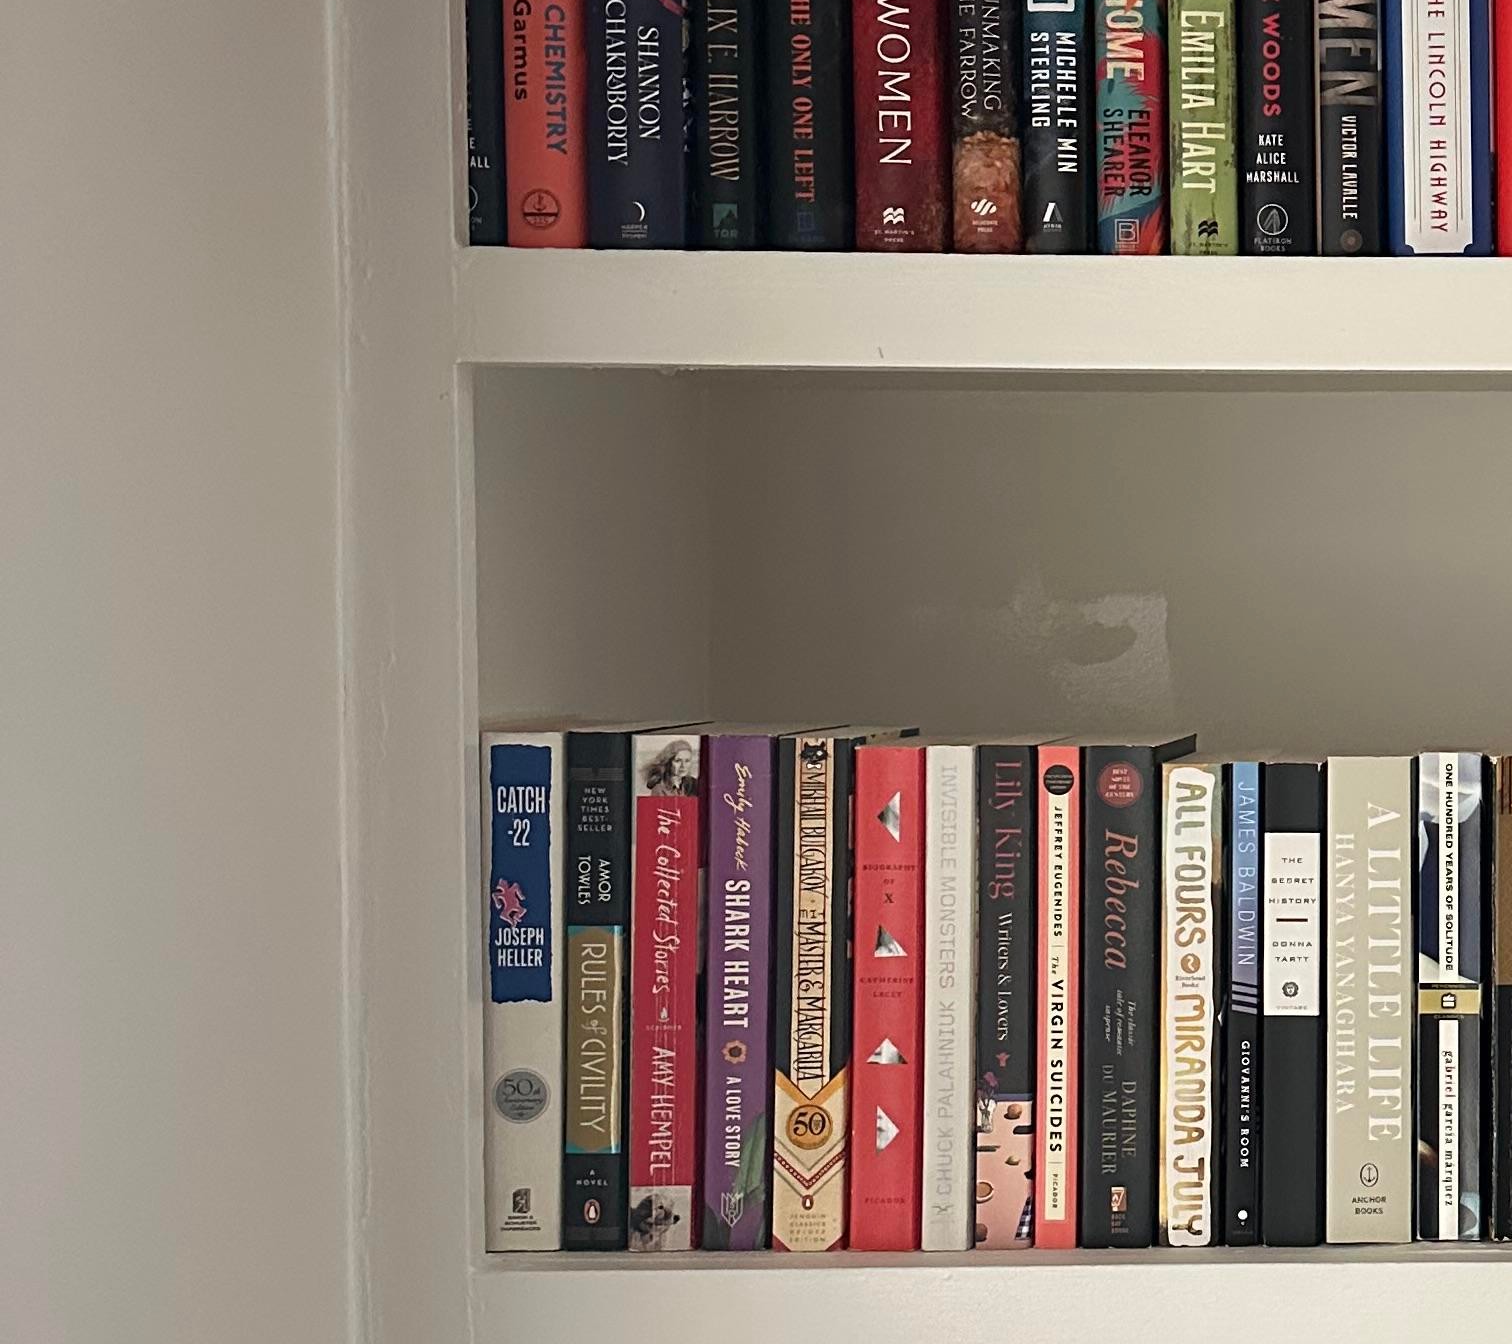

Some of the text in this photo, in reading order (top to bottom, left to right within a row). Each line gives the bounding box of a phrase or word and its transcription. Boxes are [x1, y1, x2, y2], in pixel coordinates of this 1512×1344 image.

[544, 0, 567, 154] CHEMISTRY
[1032, 32, 1051, 128] STERLING
[1056, 32, 1078, 173] MICHELLE MIN
[1428, 31, 1447, 126] LINCOLN
[1247, 169, 1299, 184] MARSHALL
[1256, 151, 1287, 165] ALICE
[1258, 134, 1284, 148] KATE
[1431, 135, 1448, 233] HIGHWAY
[497, 786, 546, 815] CATCH
[507, 821, 530, 847] -22
[1104, 830, 1140, 970] Rebecca
[1175, 782, 1207, 947] ALL FOURS
[1269, 897, 1317, 905] HISTORY
[494, 927, 544, 947] JOSEPH
[497, 948, 543, 967] HELLER
[724, 880, 751, 1028] SHARK HEART
[1367, 802, 1402, 1141] A LITTLE LIFE
[580, 943, 607, 1132] RULES of CIVILITY
[1049, 981, 1063, 1152] VIRGIN SUICIDES
[1172, 994, 1207, 1236] MIRANDA JULY
